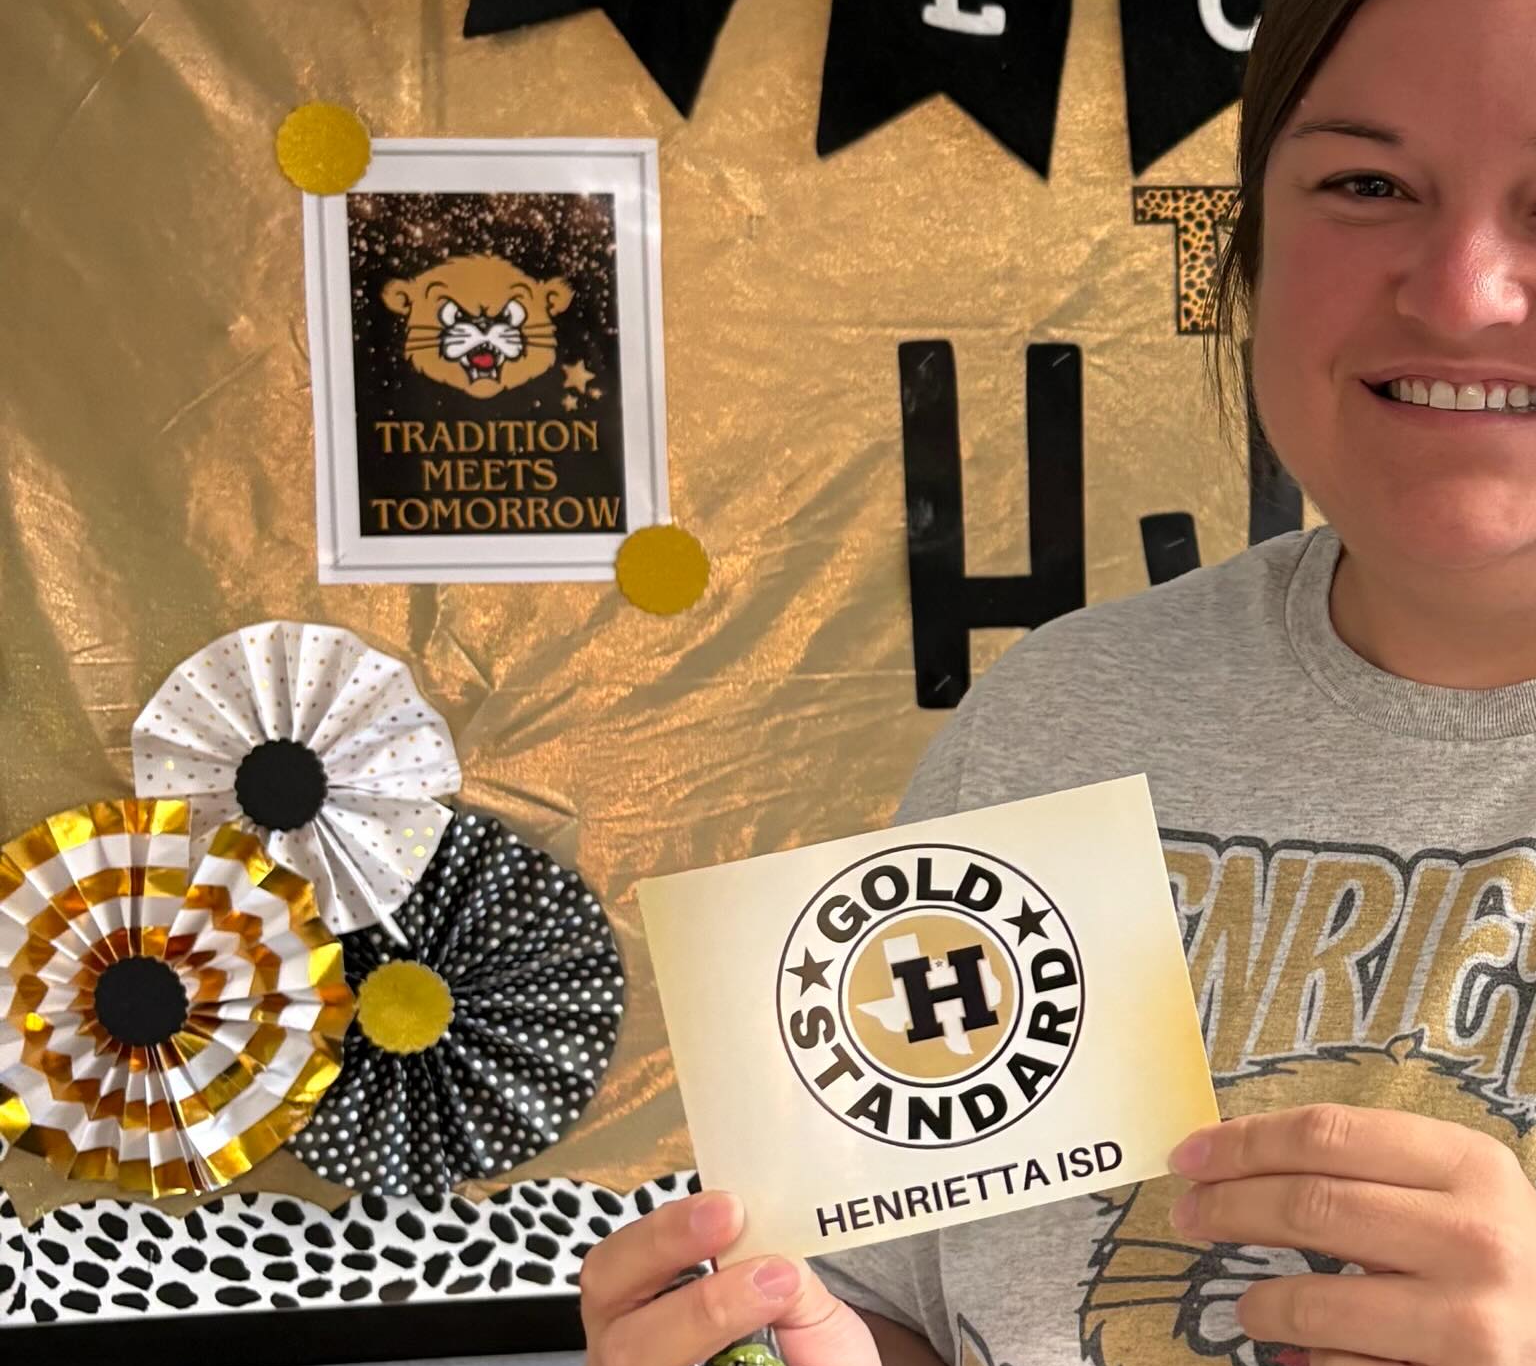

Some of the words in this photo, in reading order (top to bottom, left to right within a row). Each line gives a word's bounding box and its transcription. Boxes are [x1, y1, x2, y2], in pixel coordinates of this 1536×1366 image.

[374, 419, 599, 454] TRADITION
[422, 458, 558, 492] MEETS
[372, 496, 620, 532] TOMORROW
[816, 857, 1004, 944] GOLD
[891, 944, 1000, 1044] H
[788, 946, 1079, 1141] STANDARD
[816, 1158, 1048, 1237] HENRIETTA
[1057, 1139, 1125, 1185] ISD
